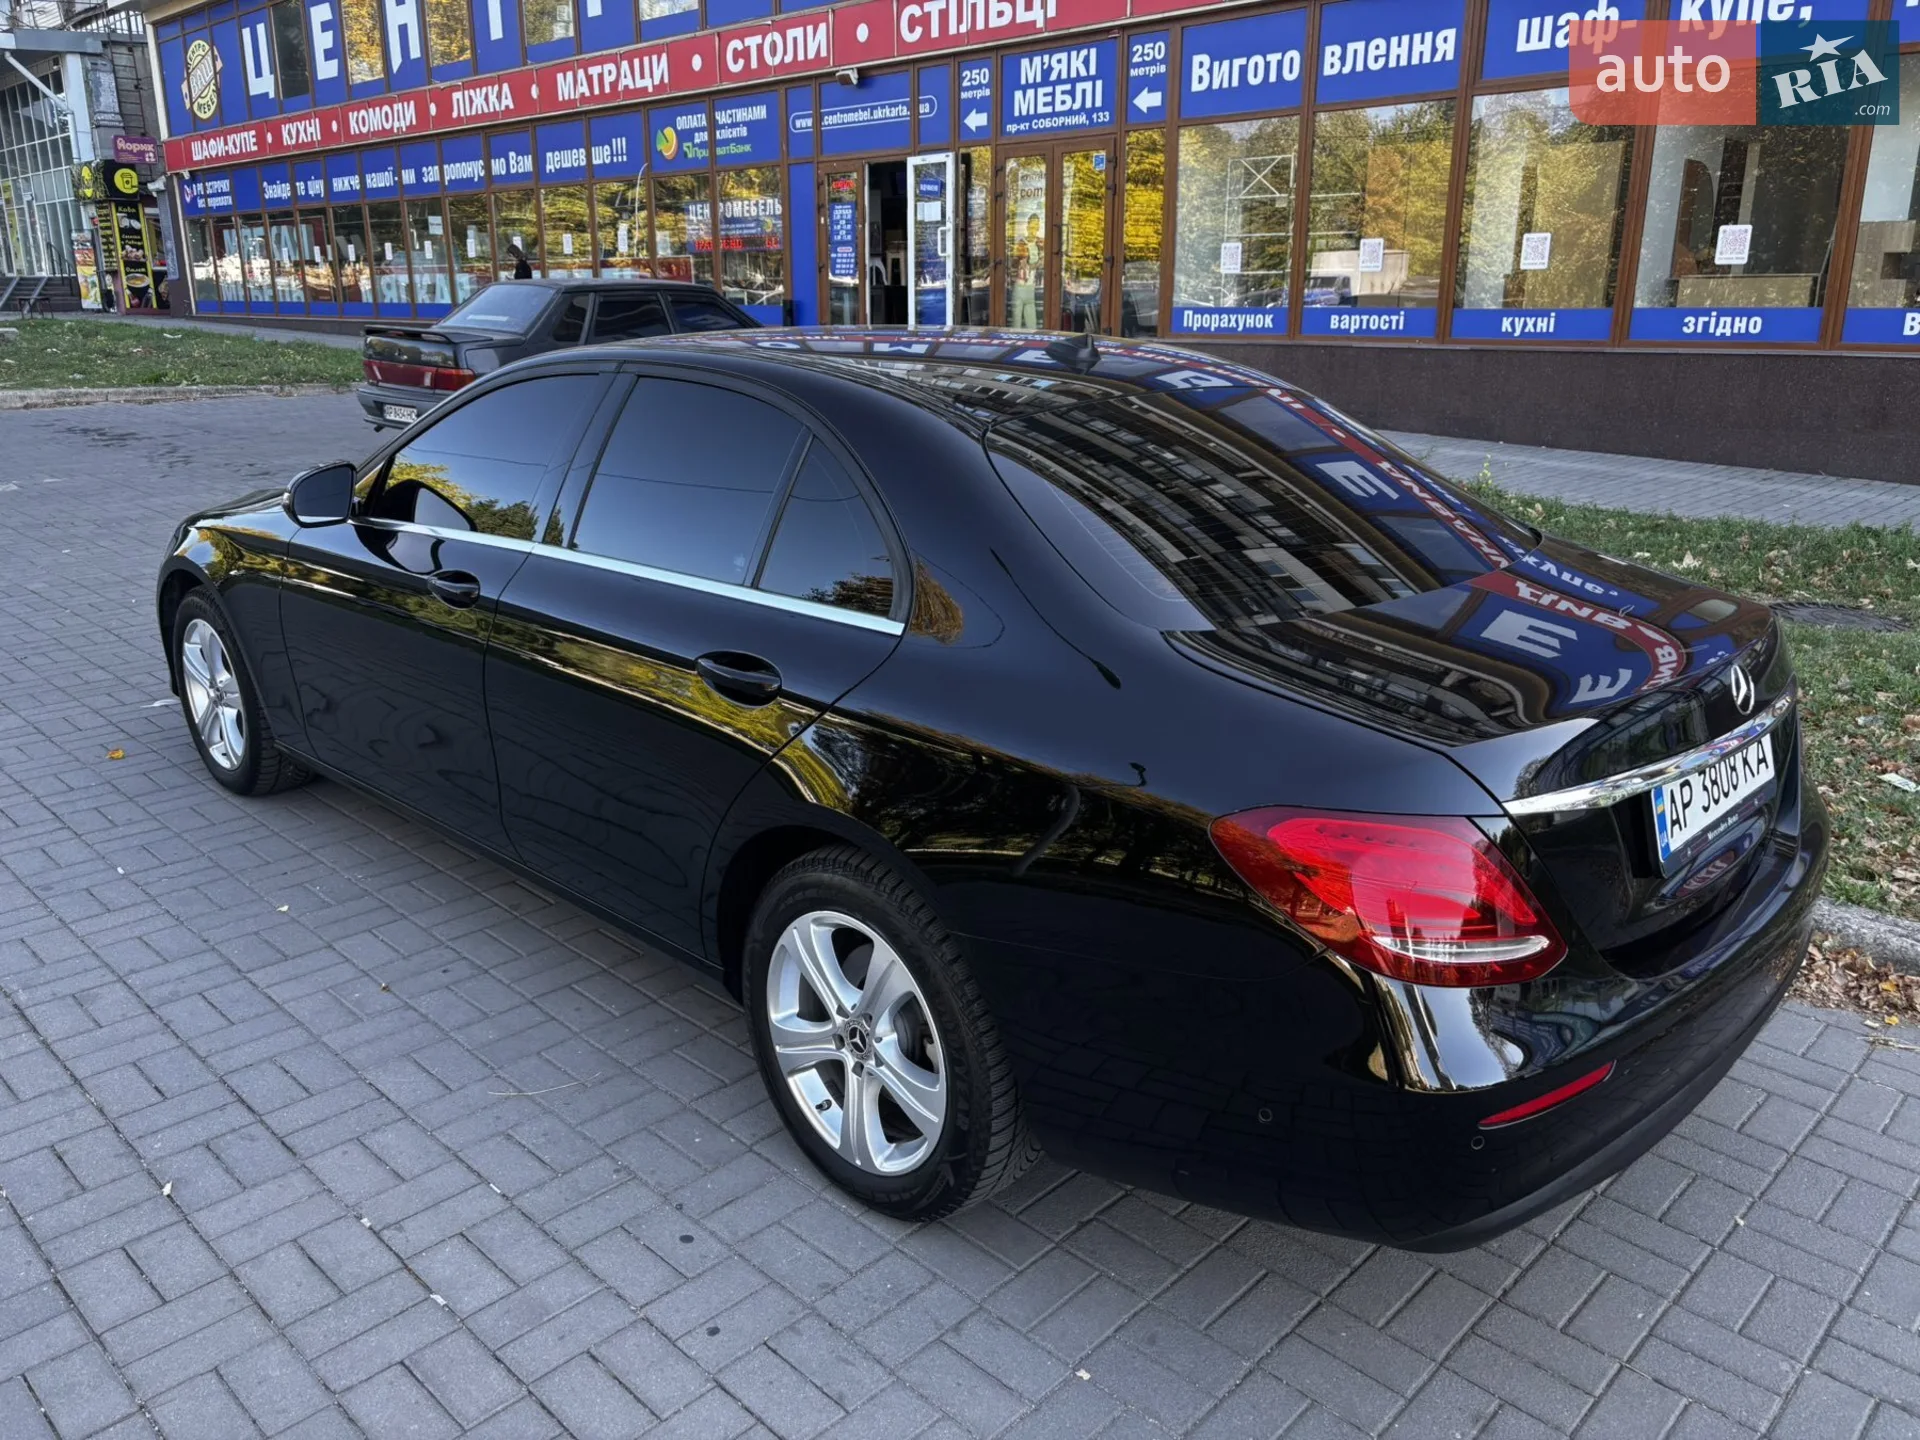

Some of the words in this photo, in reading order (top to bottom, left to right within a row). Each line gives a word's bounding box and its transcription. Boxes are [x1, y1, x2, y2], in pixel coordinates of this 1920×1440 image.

[1132, 41, 1166, 63] 250
[961, 68, 989, 87] 250
[1020, 48, 1097, 85] М'ЯКІ
[1130, 63, 1166, 78] метрів
[191, 130, 257, 161] ШАФИ-КУПЕ
[281, 118, 321, 146] КУХНІ
[349, 100, 417, 135] КОМОДИ
[452, 82, 515, 118] ЛІЖКА
[556, 52, 669, 101] МАТРАЦИ
[726, 22, 827, 73] СТОЛИ
[960, 87, 991, 100] метрів
[1013, 79, 1103, 117] МЕБЛІ
[676, 112, 707, 130] ОПЛАТА
[715, 104, 767, 125] ЧАСТИНАМИ
[1006, 121, 1030, 133] пр-кт
[1032, 112, 1090, 130] СОБОРНИЙ,
[1092, 111, 1110, 123] 133
[694, 131, 708, 144] для
[716, 124, 748, 141] клієнтів
[308, 176, 325, 198] ціну
[332, 174, 360, 193] нижче
[402, 168, 416, 185] ми
[509, 151, 533, 173] Вам
[1183, 310, 1273, 330] Прорахунок
[1330, 311, 1404, 333] вартості
[1501, 312, 1556, 336] кухні
[1682, 311, 1763, 336] згідно
[1670, 779, 1693, 839] AP
[1698, 755, 1739, 813] 3808
[1742, 740, 1769, 784] KA
